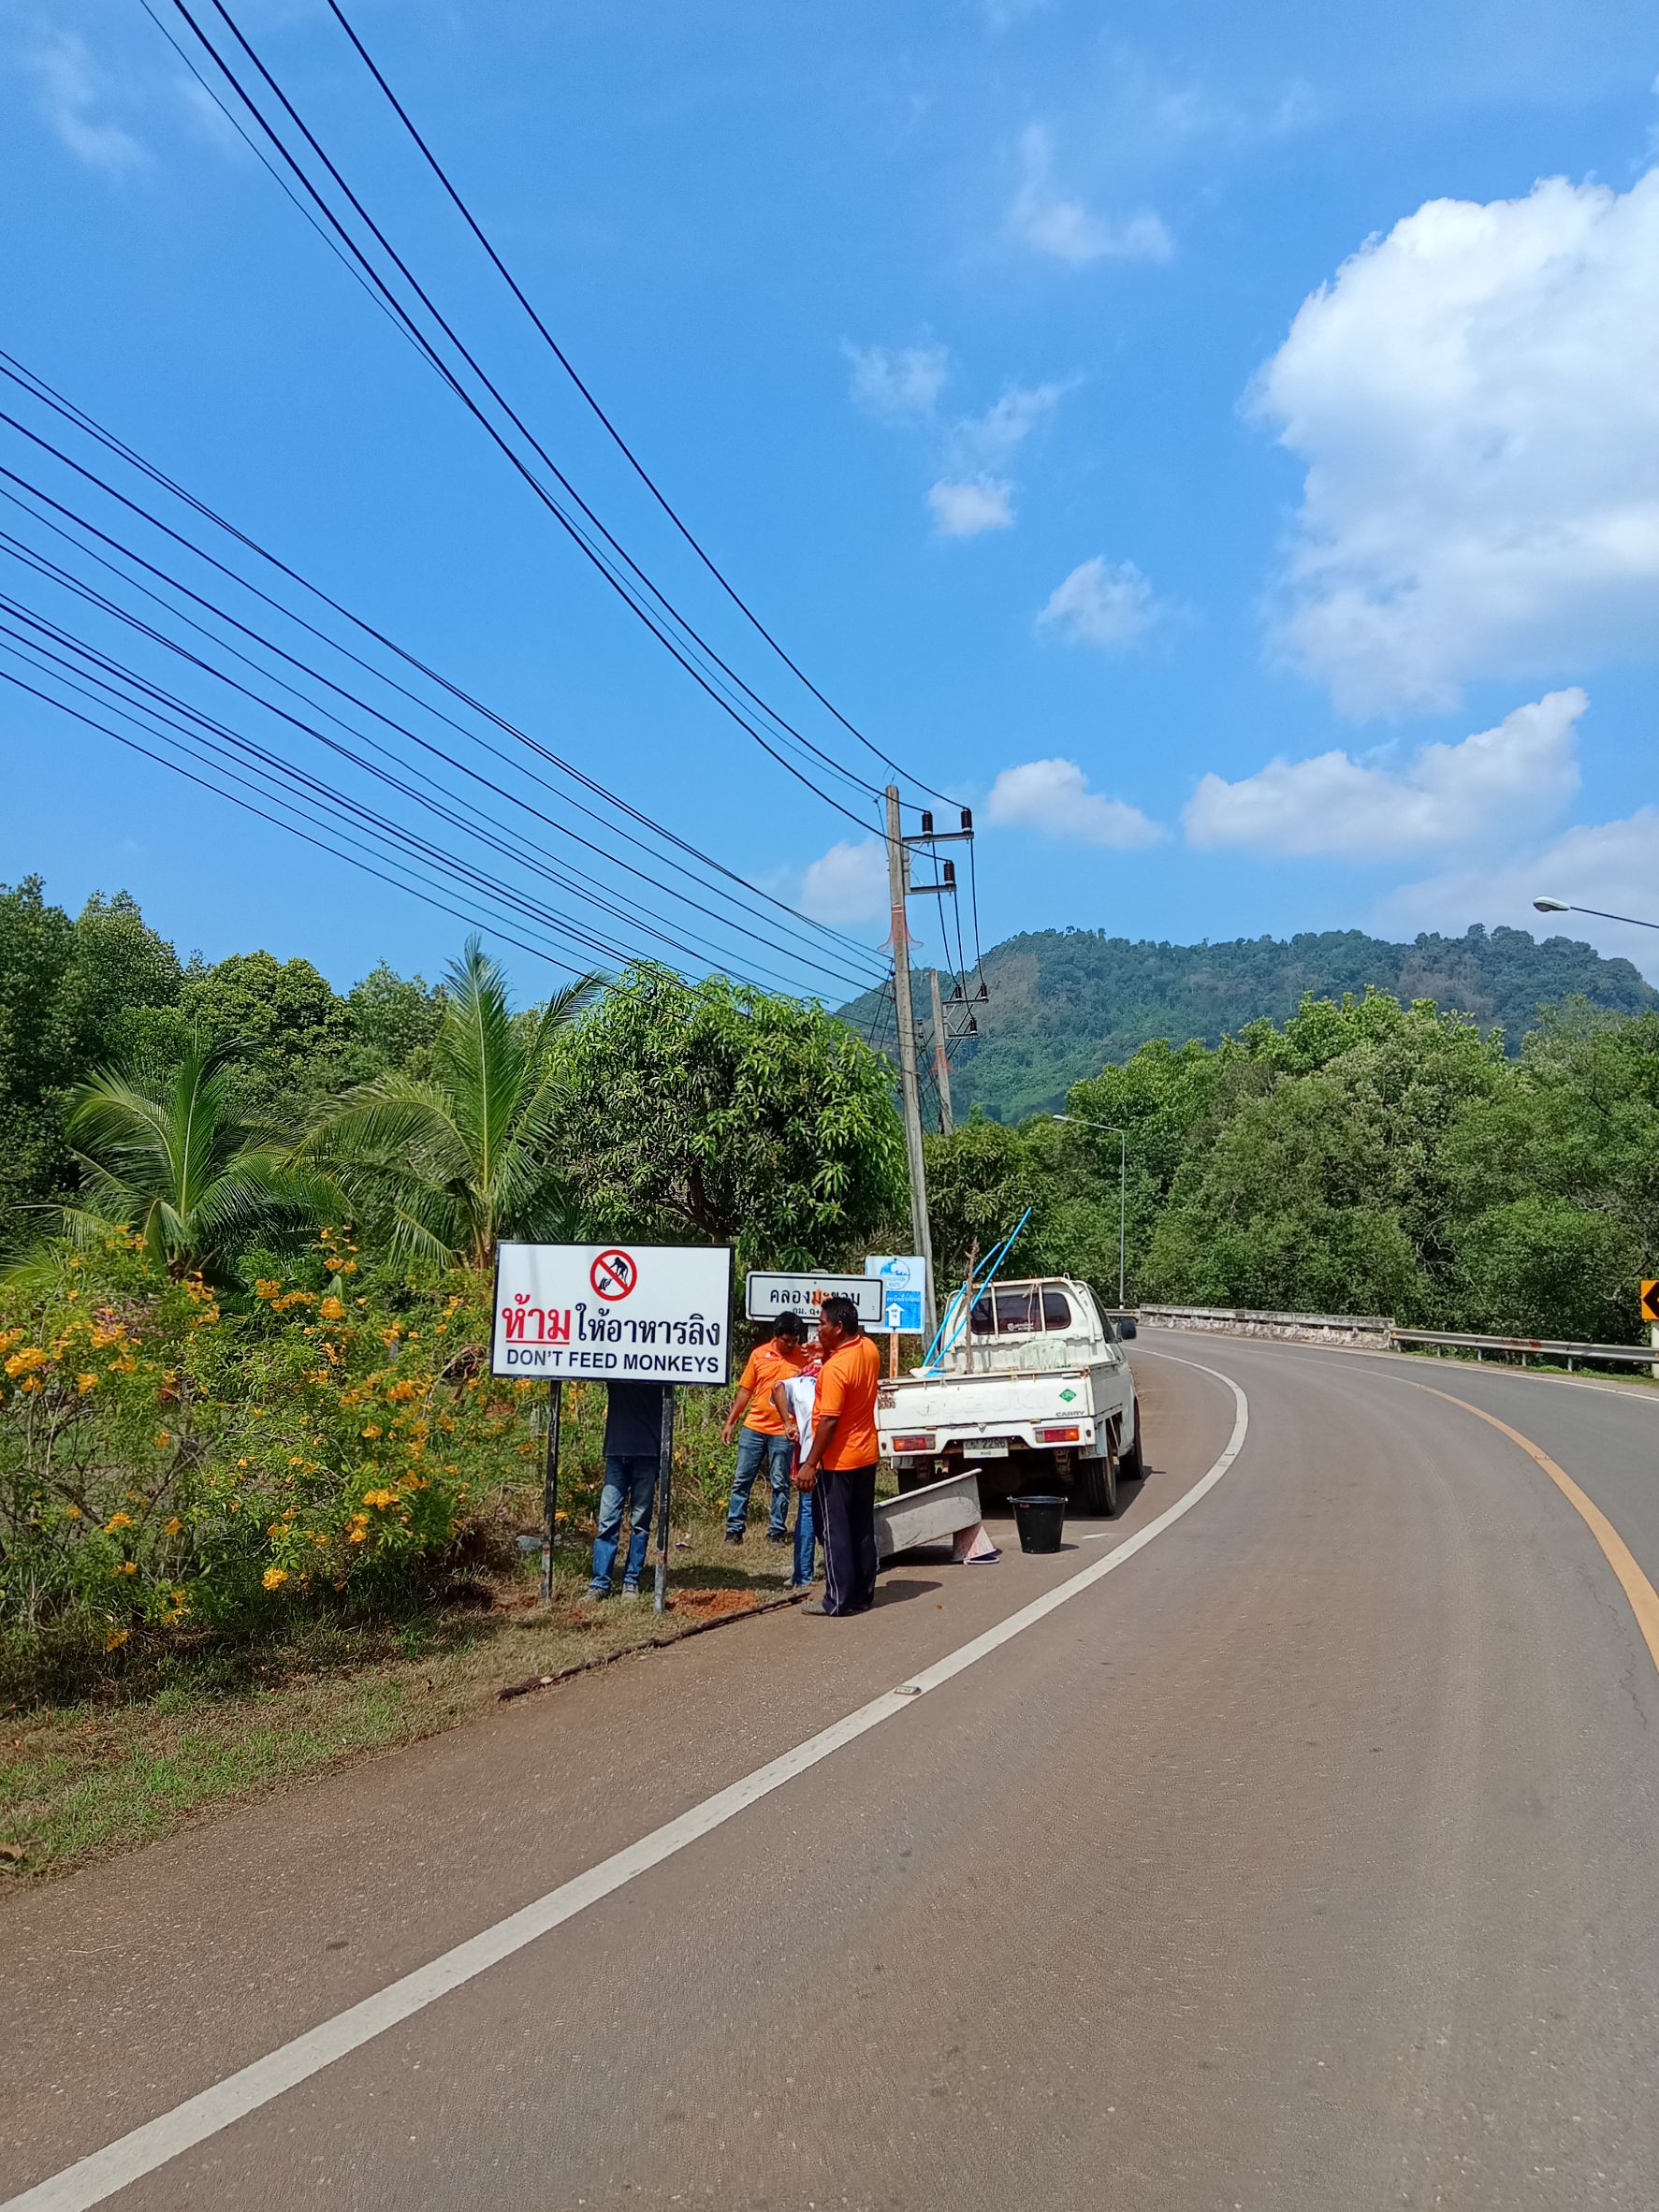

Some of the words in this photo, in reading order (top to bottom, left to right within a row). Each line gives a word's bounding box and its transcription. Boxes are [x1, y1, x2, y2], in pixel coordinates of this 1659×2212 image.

[502, 1293, 571, 1340] ห้าม
[575, 1302, 720, 1346] ให้อาหารลิง
[506, 1348, 563, 1367] DON'T
[568, 1351, 618, 1370] FEED
[623, 1354, 719, 1374] MONKEYS
